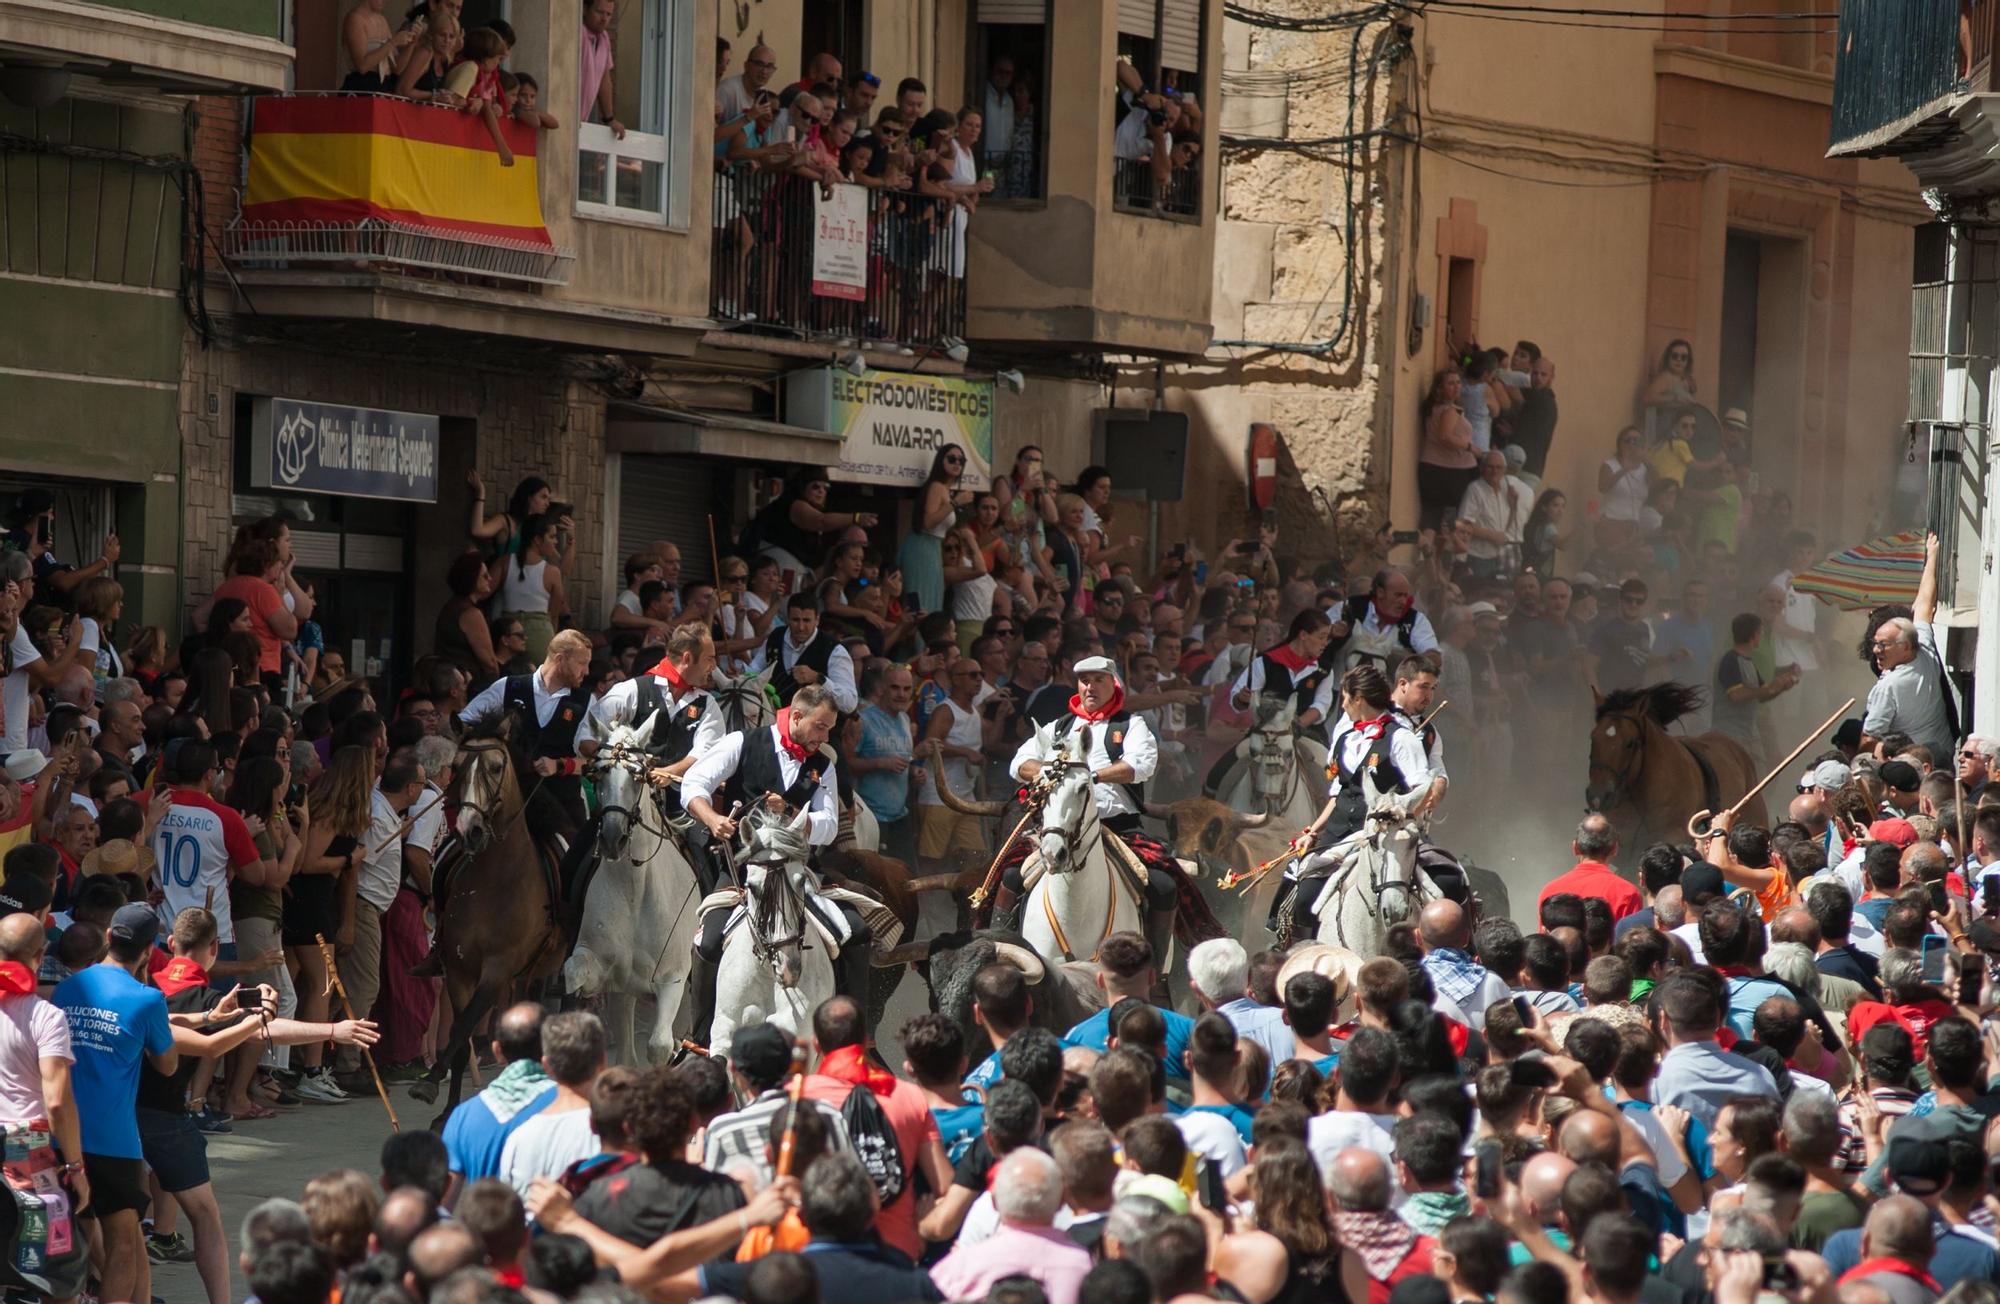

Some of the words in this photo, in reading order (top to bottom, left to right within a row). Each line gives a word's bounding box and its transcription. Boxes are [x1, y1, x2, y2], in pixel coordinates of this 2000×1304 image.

[832, 376, 989, 418] ELECTRODOMÉSTICOS
[351, 420, 398, 473] Veterinaria
[399, 424, 433, 487] Segorbe
[872, 421, 944, 451] NAVARRO
[160, 831, 201, 888] 10
[0, 894, 23, 909] didas
[83, 1018, 121, 1036] TORRES
